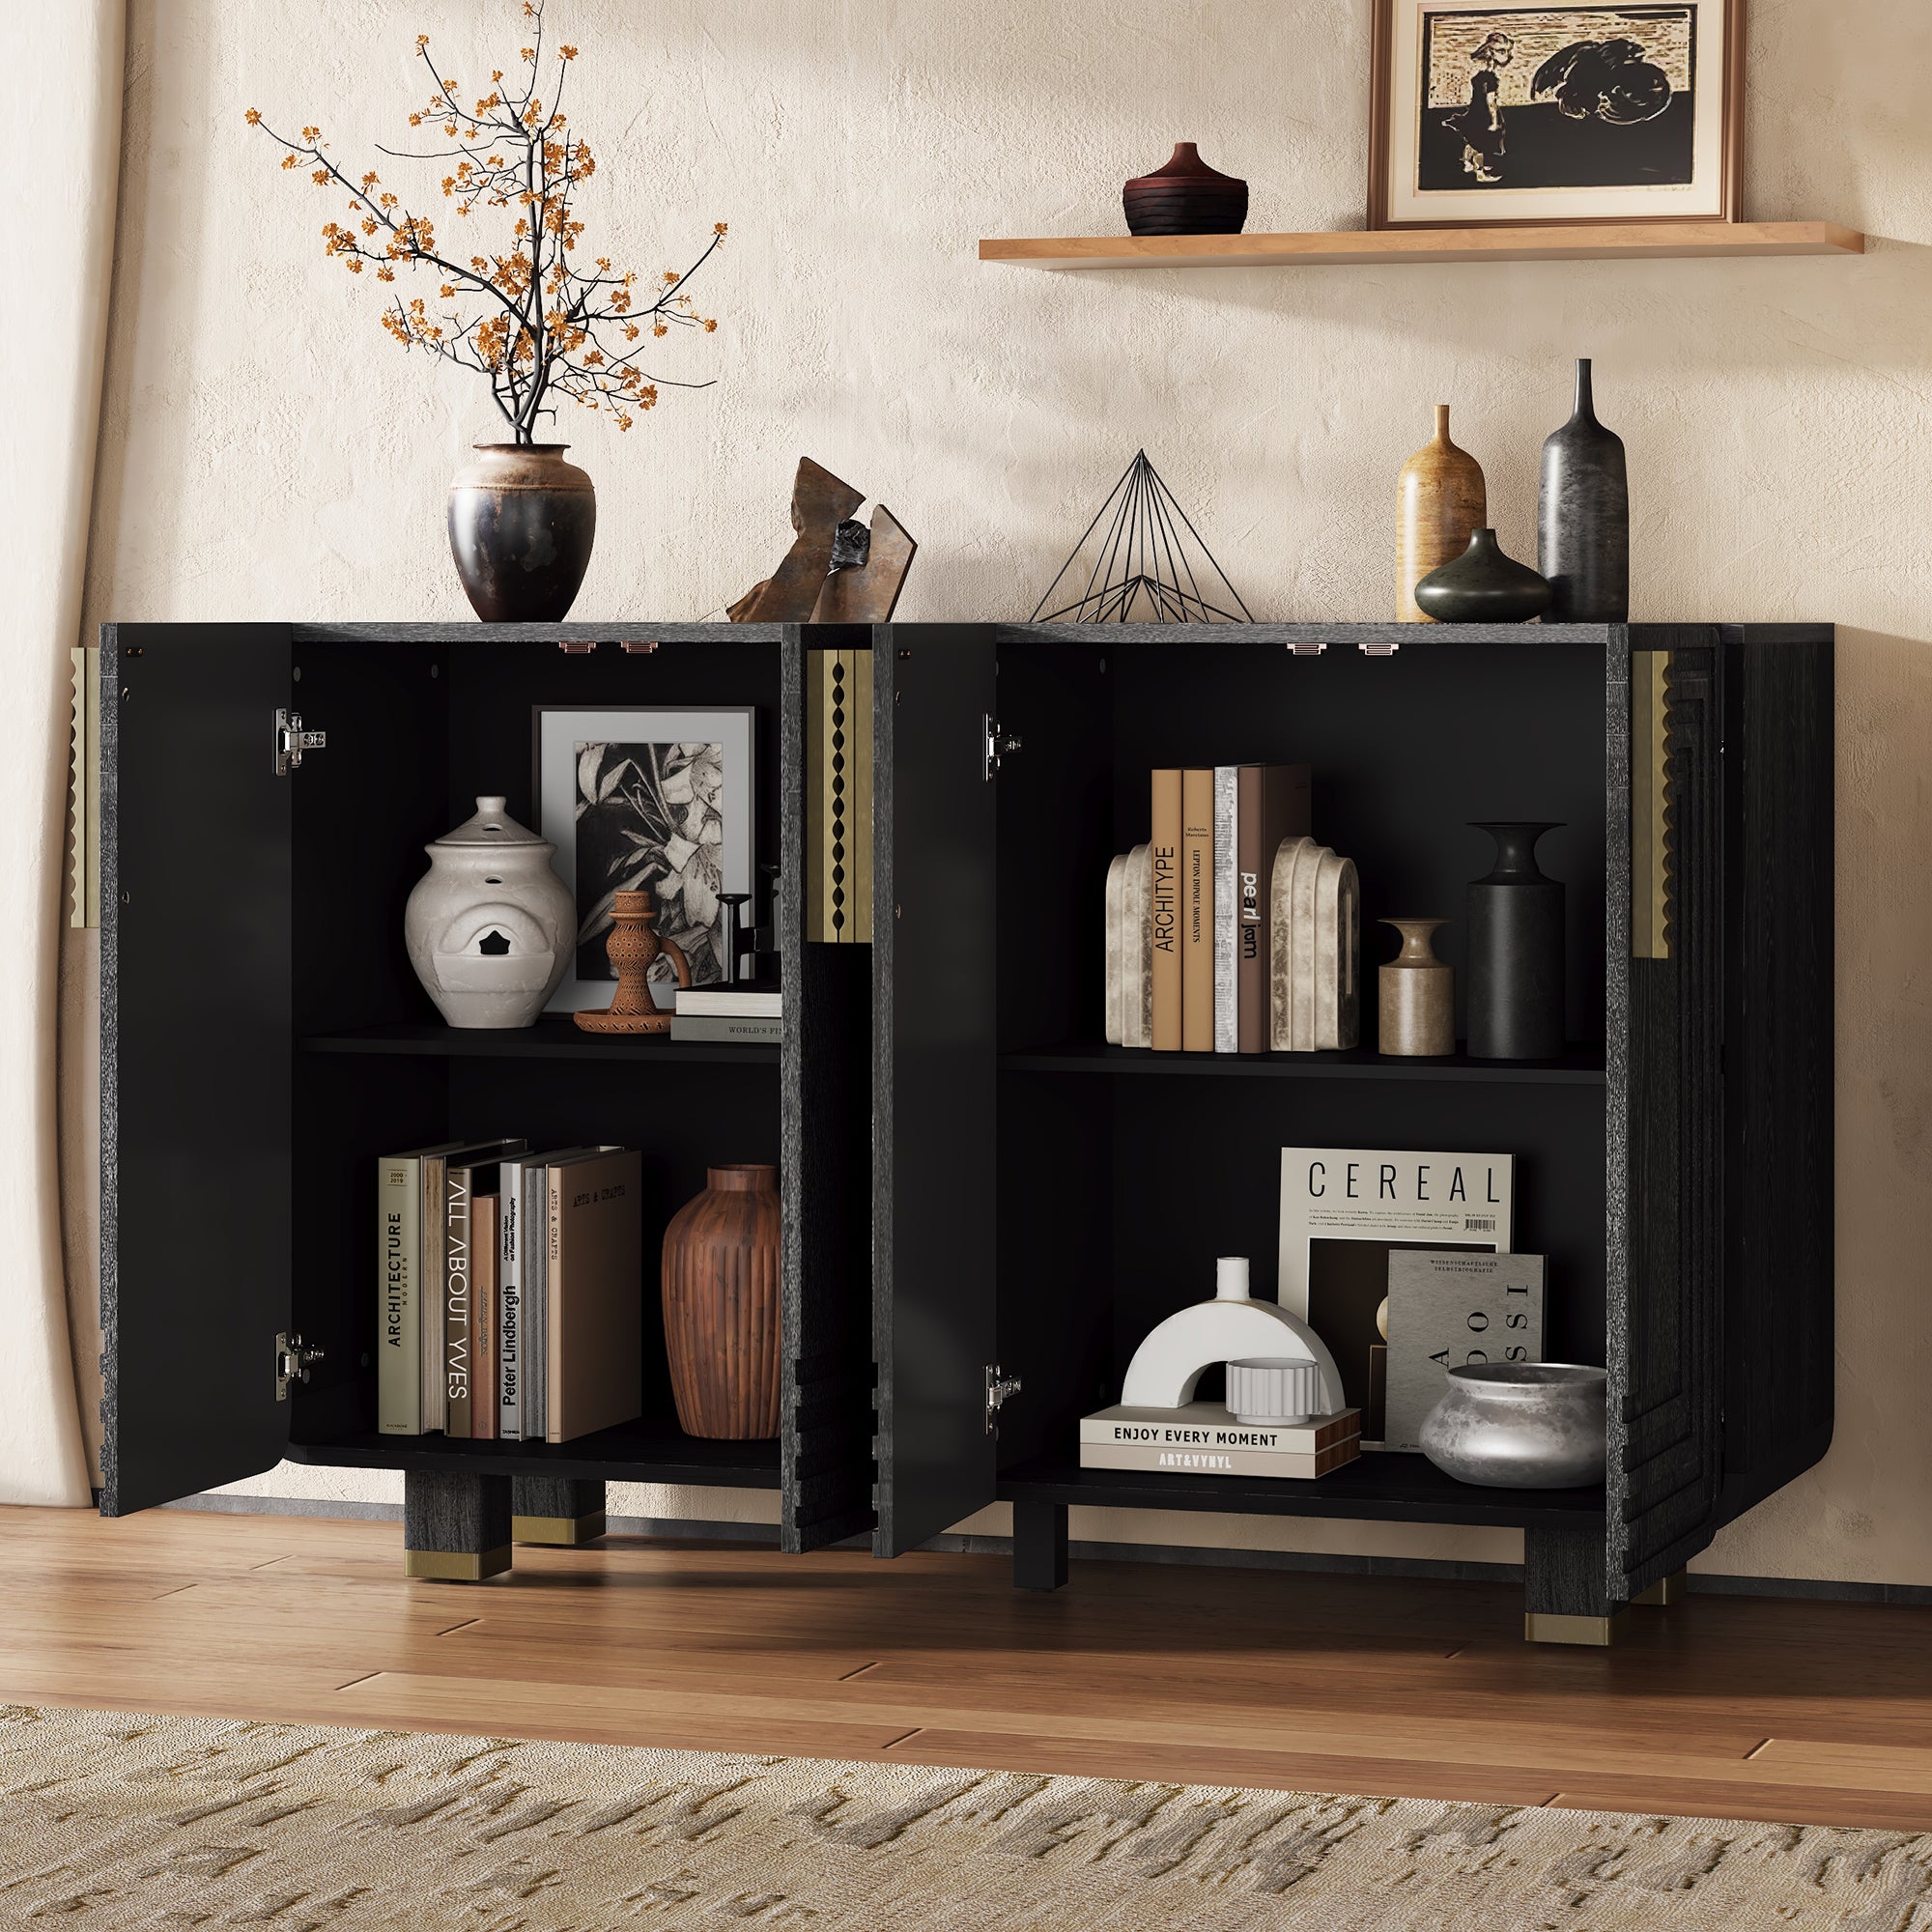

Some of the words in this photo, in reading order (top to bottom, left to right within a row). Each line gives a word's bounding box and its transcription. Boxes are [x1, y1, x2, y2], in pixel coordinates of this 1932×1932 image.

[1154, 846, 1174, 952] ARCHITYPE
[448, 1179, 468, 1227] ALL
[1308, 1161, 1500, 1203] CEREAL
[388, 1213, 401, 1348] ARCHITECTURE
[448, 1236, 468, 1326] ABOUT
[502, 1285, 520, 1363] Lindbergh
[448, 1337, 468, 1399] YVES
[502, 1366, 517, 1406] Peter
[1114, 1427, 1160, 1441] ENJOY
[1165, 1430, 1210, 1444] EVERY
[1216, 1433, 1278, 1447] MOMENT
[1158, 1452, 1232, 1470] ART&VYNYL
